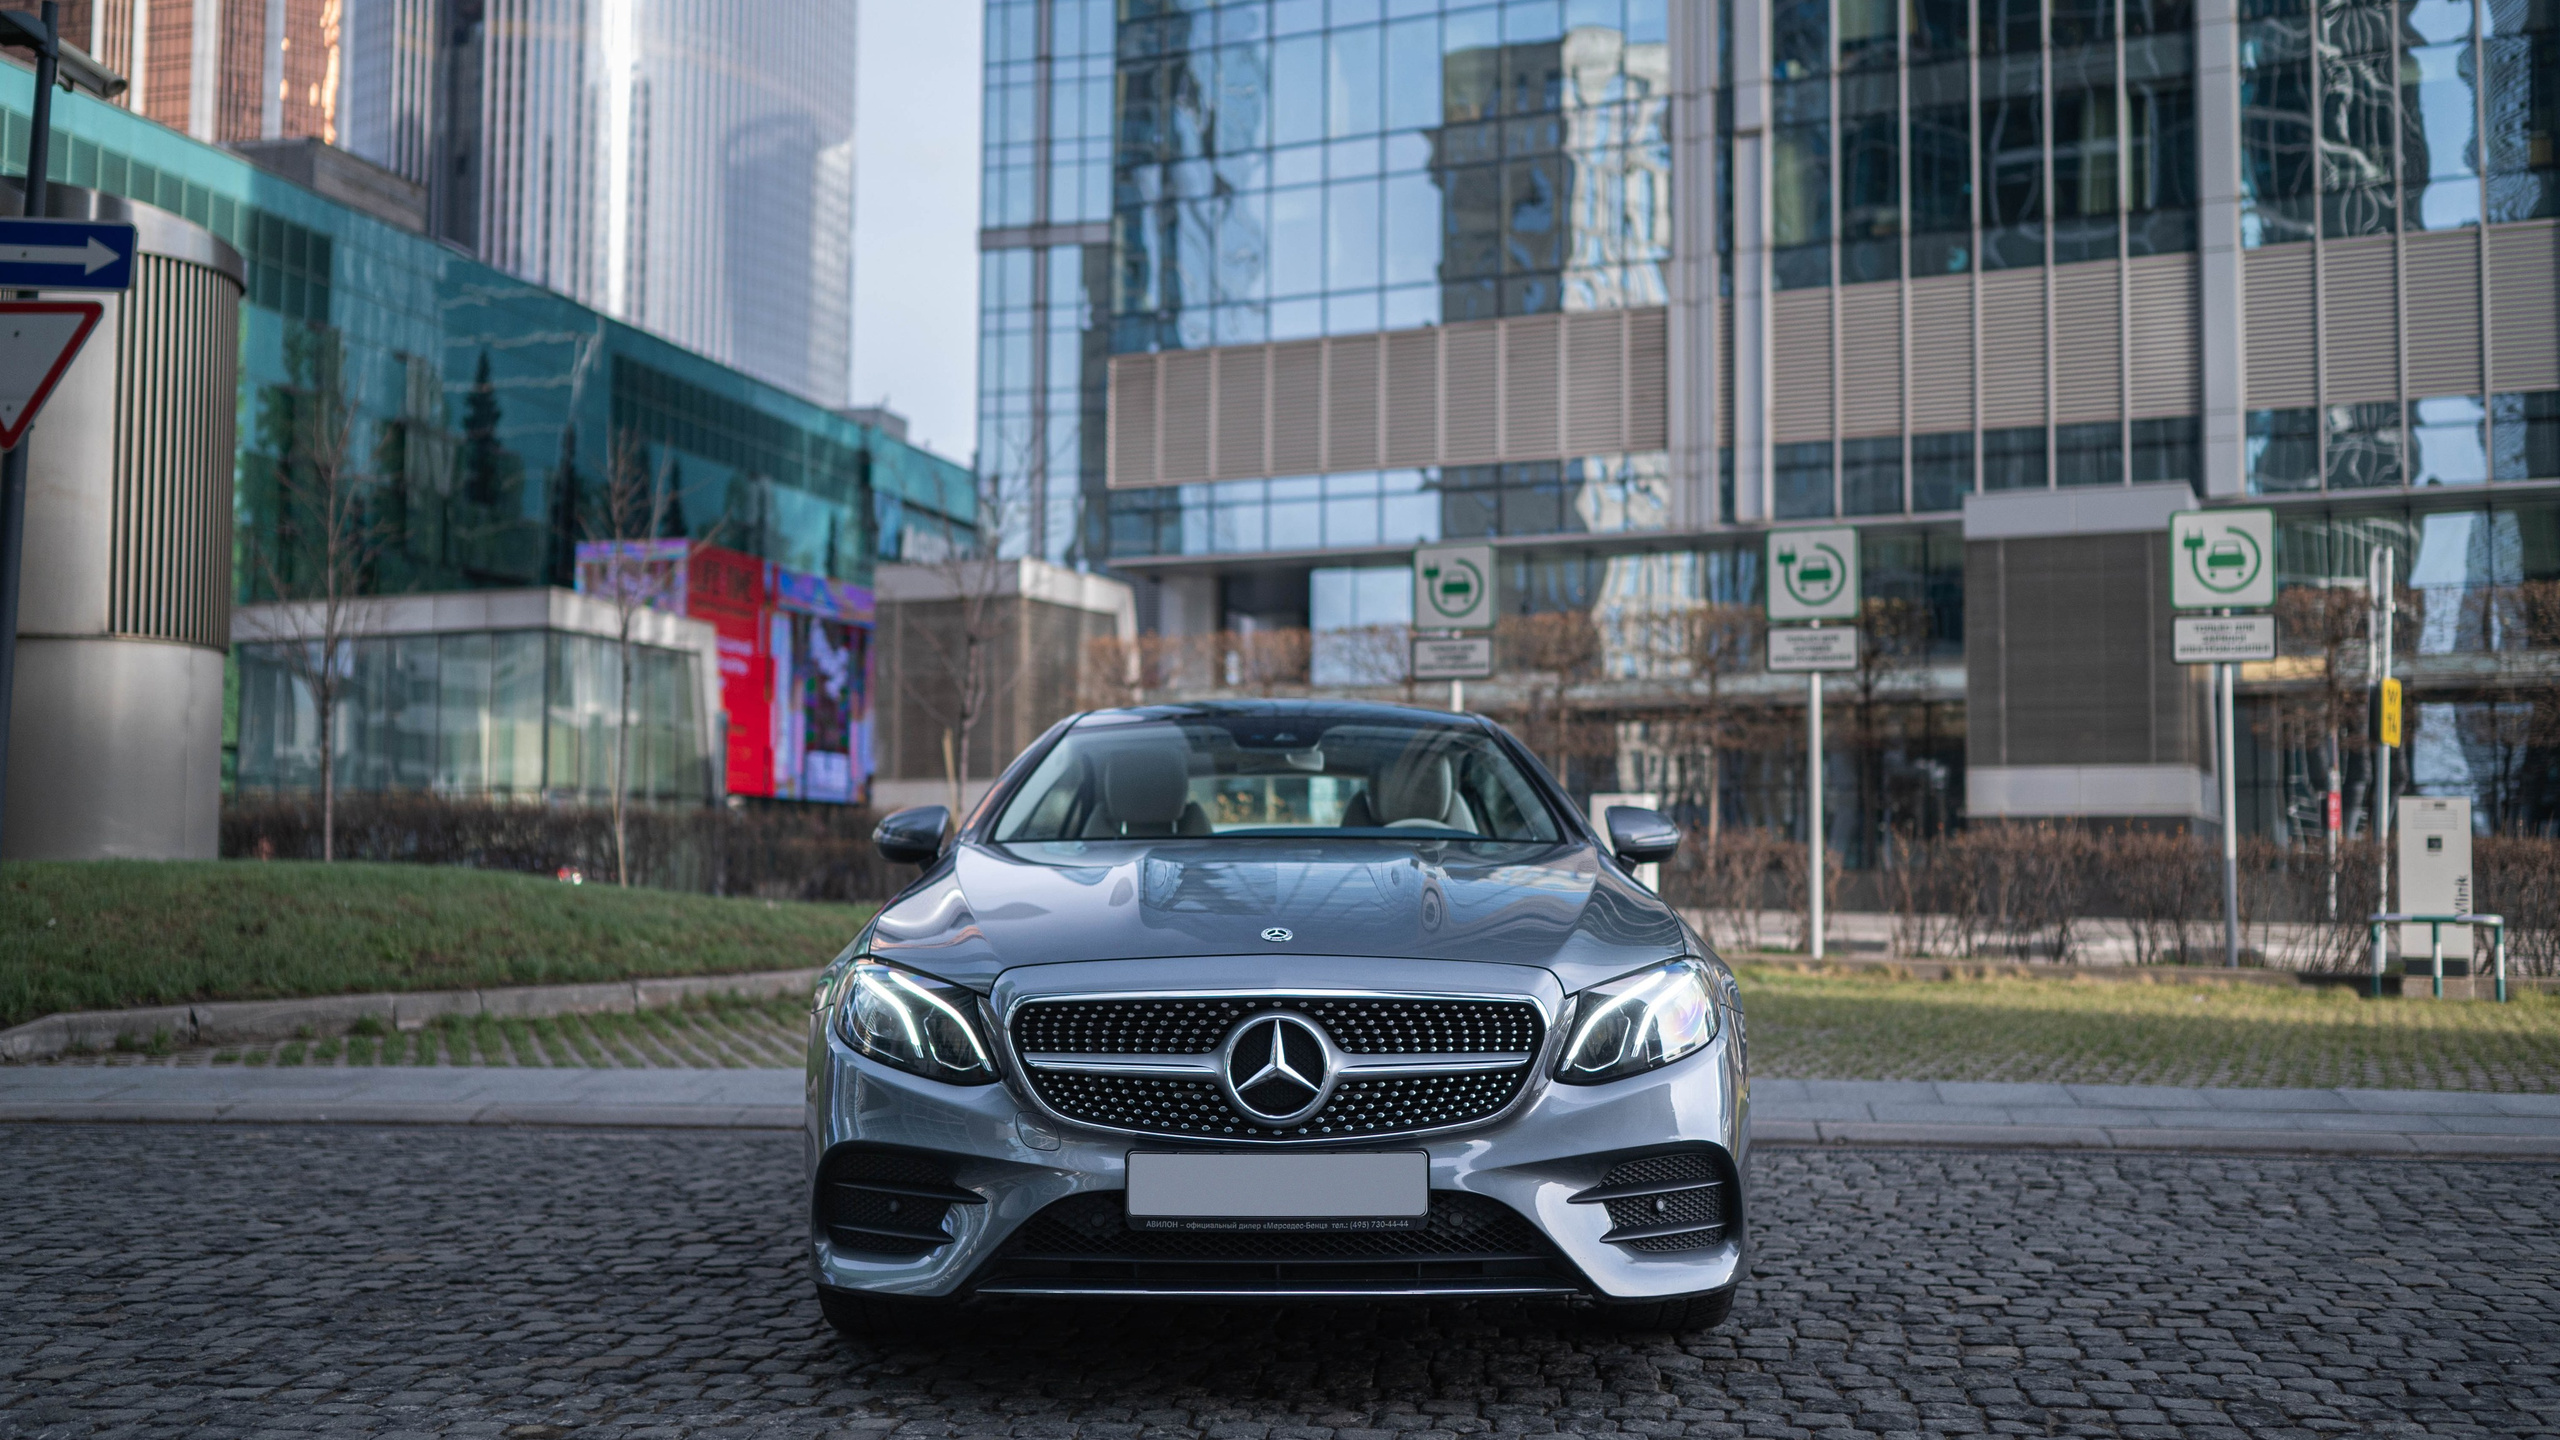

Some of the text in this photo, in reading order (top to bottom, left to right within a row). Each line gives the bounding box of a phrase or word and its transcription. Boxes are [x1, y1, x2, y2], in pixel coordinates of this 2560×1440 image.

[1146, 1220, 1178, 1228] АВИЛОН
[1186, 1221, 1237, 1230] официальный
[1238, 1222, 1261, 1230] дилер
[1349, 1221, 1370, 1230] (495)
[1371, 1220, 1409, 1228] 730-44-44
